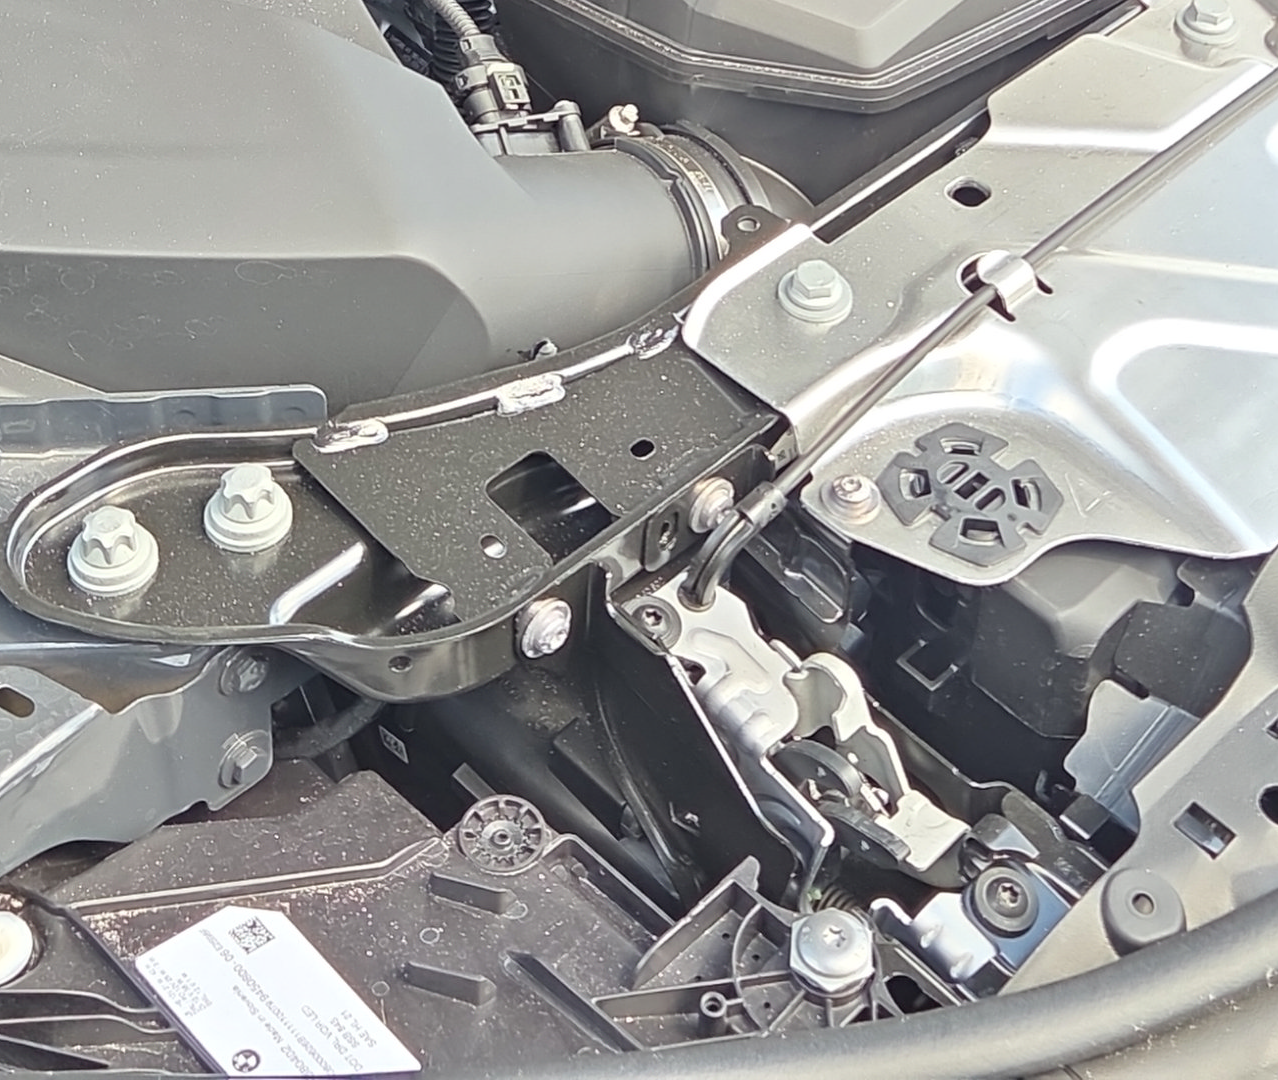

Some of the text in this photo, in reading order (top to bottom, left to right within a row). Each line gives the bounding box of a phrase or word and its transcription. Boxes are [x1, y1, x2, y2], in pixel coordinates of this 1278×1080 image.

[233, 985, 259, 1016] Slovenia
[257, 1015, 266, 1023] in
[301, 1005, 318, 1022] LED
[264, 1022, 283, 1044] Made
[359, 1030, 376, 1048] SAE
[332, 1036, 348, 1055] DRL
[344, 1054, 364, 1072] DOT
